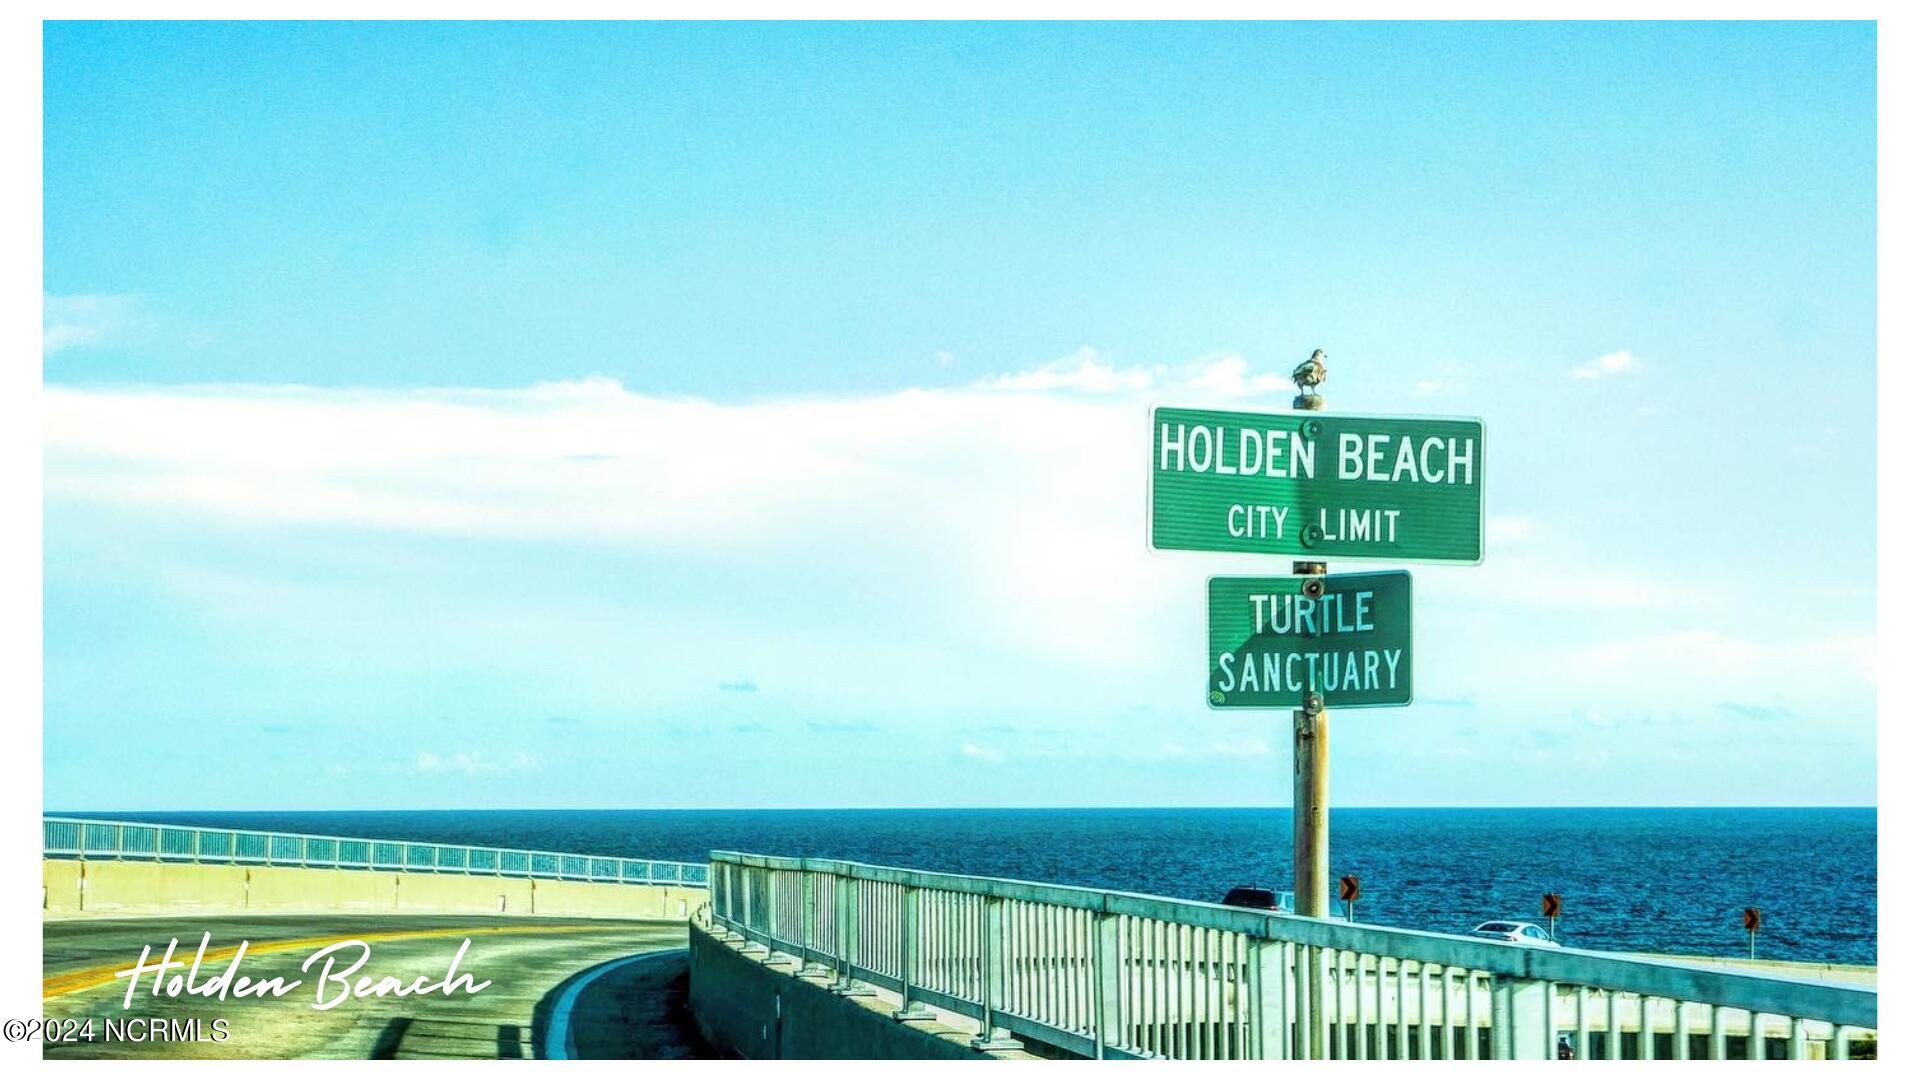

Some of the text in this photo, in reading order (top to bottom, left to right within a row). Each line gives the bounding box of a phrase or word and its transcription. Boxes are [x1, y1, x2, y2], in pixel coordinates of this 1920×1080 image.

[1160, 423, 1473, 484] HOLDEN BEACH
[1228, 504, 1399, 542] CITY LIMIT
[1249, 591, 1374, 634] TURTLE
[1218, 649, 1401, 692] SANCTUARY
